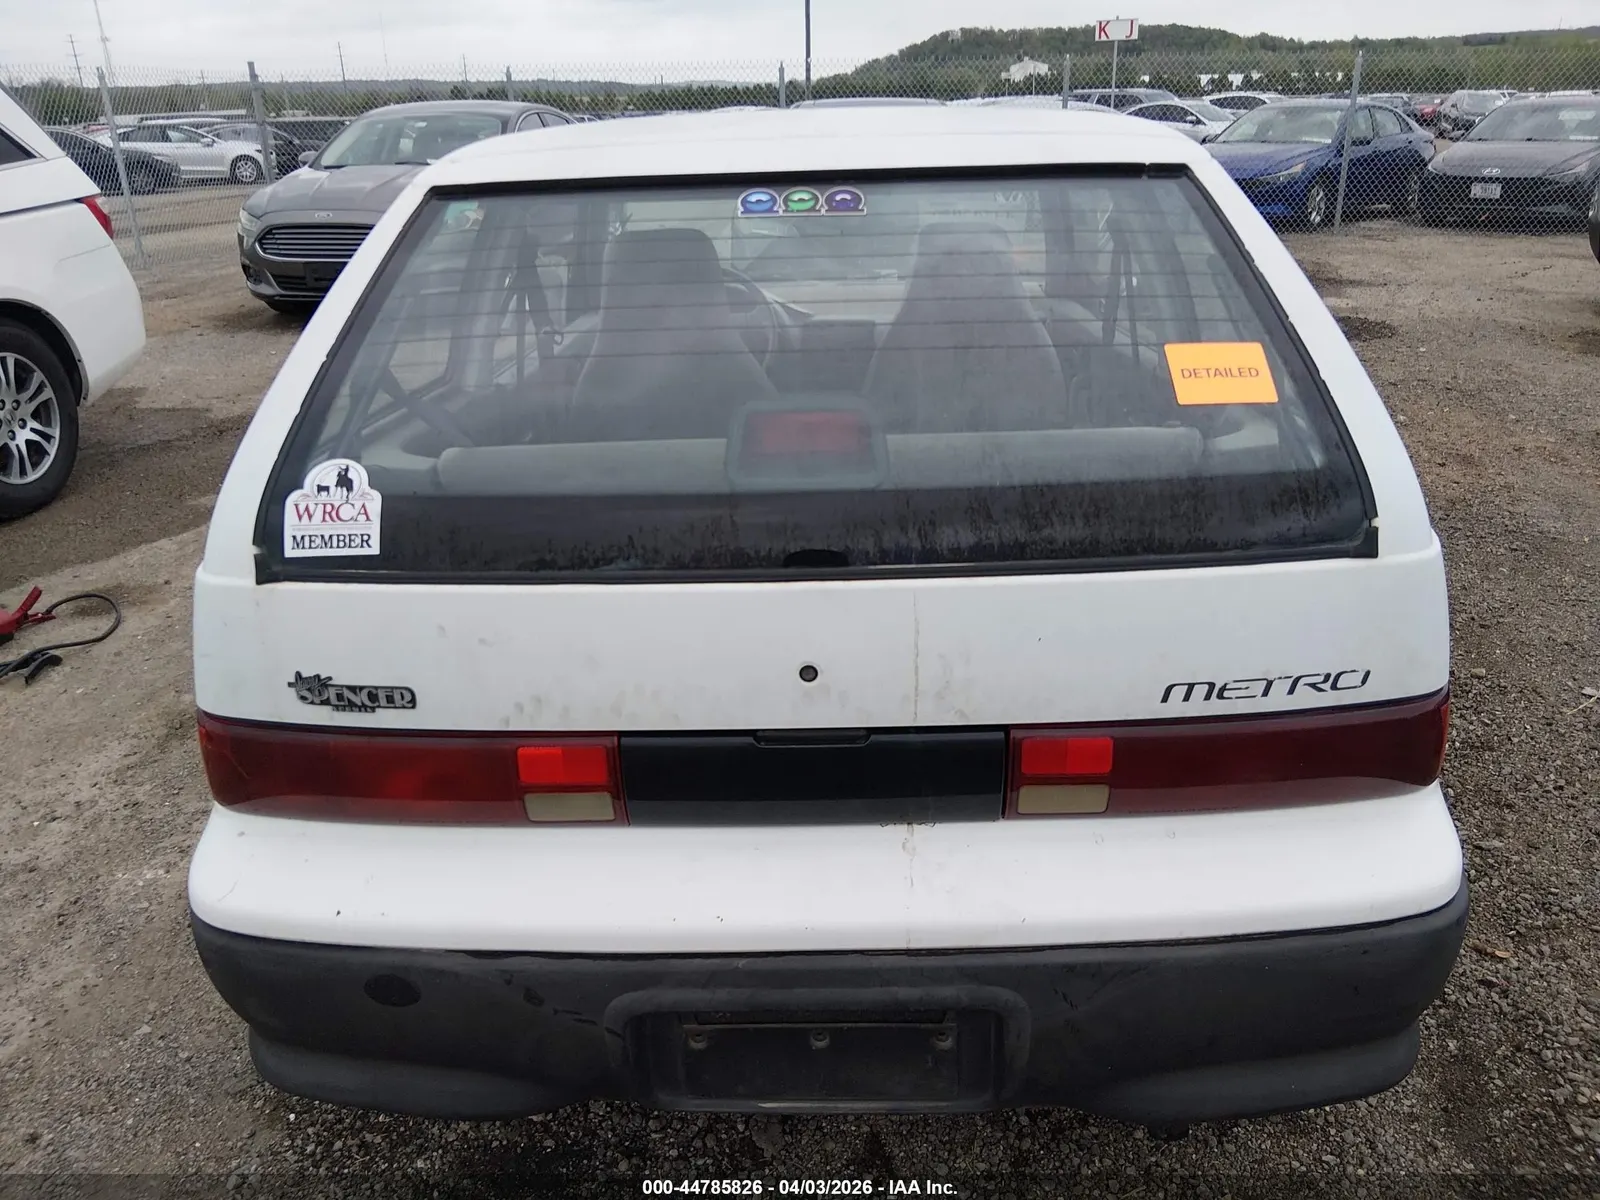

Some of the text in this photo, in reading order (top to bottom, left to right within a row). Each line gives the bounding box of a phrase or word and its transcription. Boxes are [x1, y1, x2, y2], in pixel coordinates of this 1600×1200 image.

[1098, 19, 1134, 40] K J
[1180, 367, 1260, 379] DETAILED
[294, 502, 373, 523] WRCA
[291, 533, 373, 550] MEMBER
[298, 685, 415, 708] SPENCER
[1160, 669, 1371, 703] METRO
